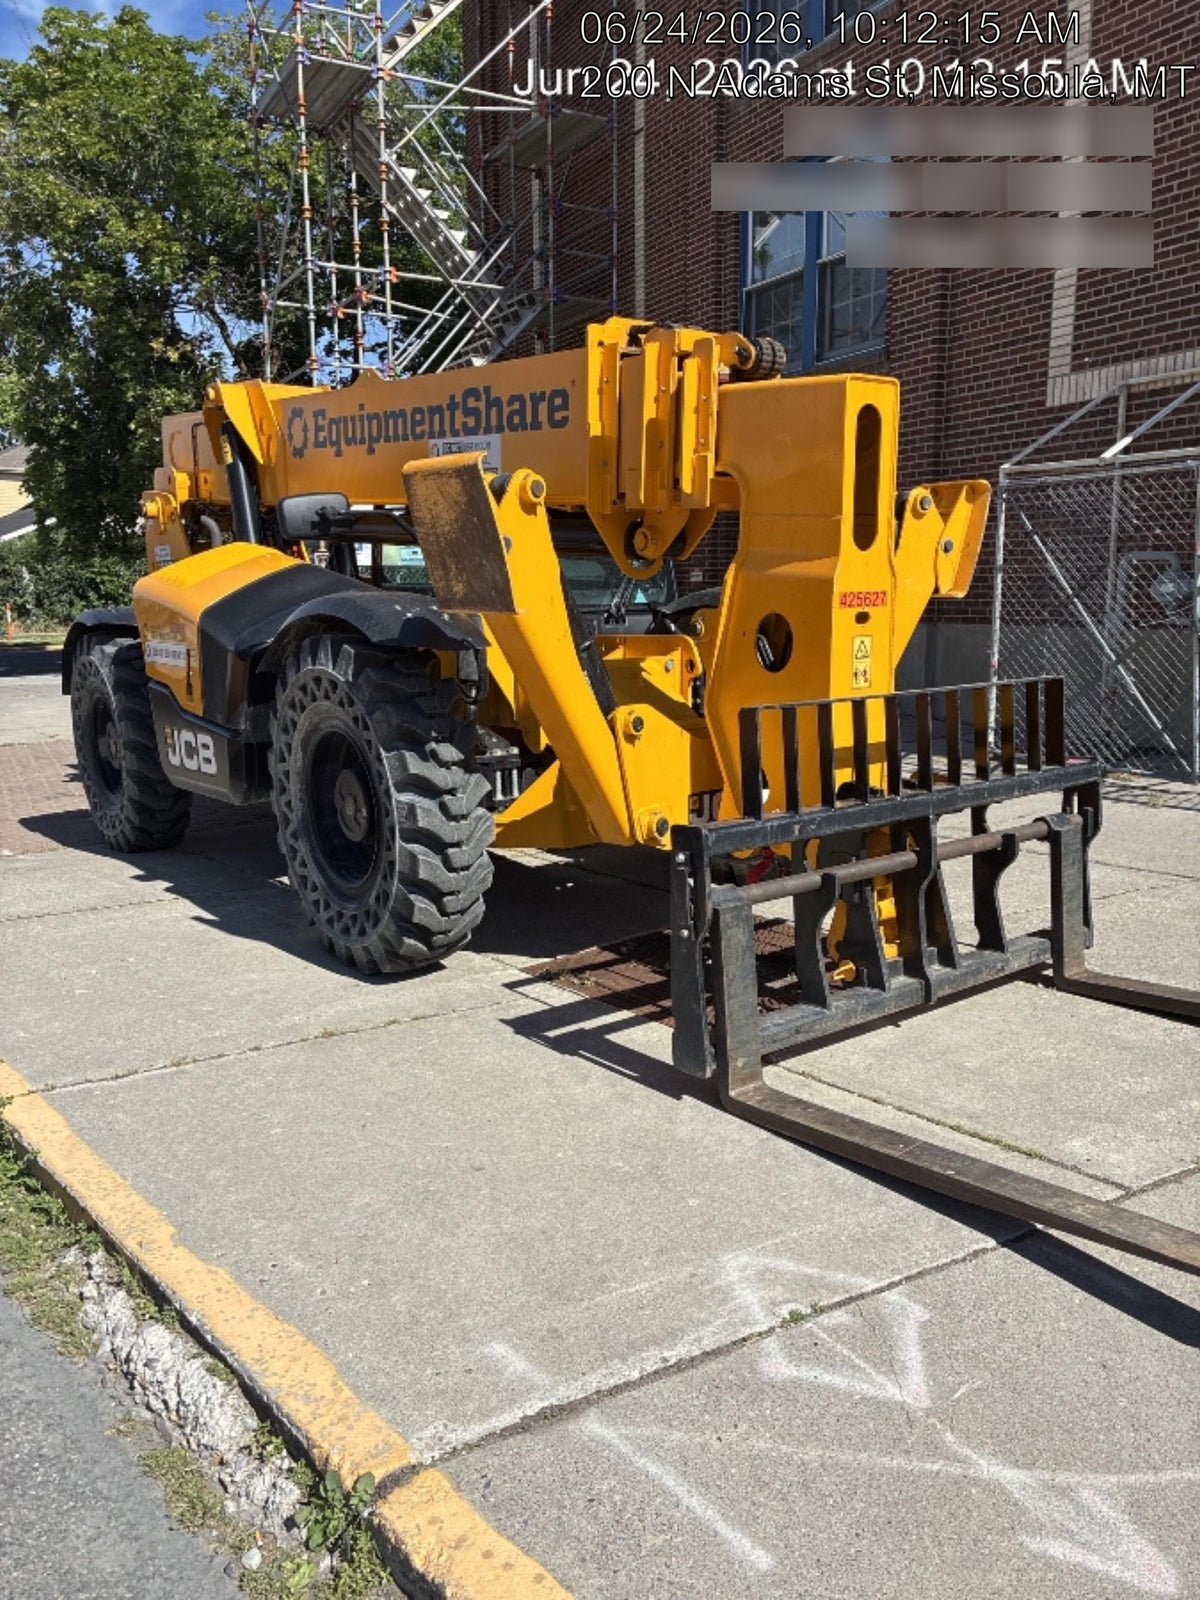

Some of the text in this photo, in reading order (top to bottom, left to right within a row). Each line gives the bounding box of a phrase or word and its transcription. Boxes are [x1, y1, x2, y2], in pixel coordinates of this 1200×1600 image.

[312, 385, 570, 457] EquipmentShare
[839, 591, 887, 608] 425627
[168, 729, 218, 775] JCB
